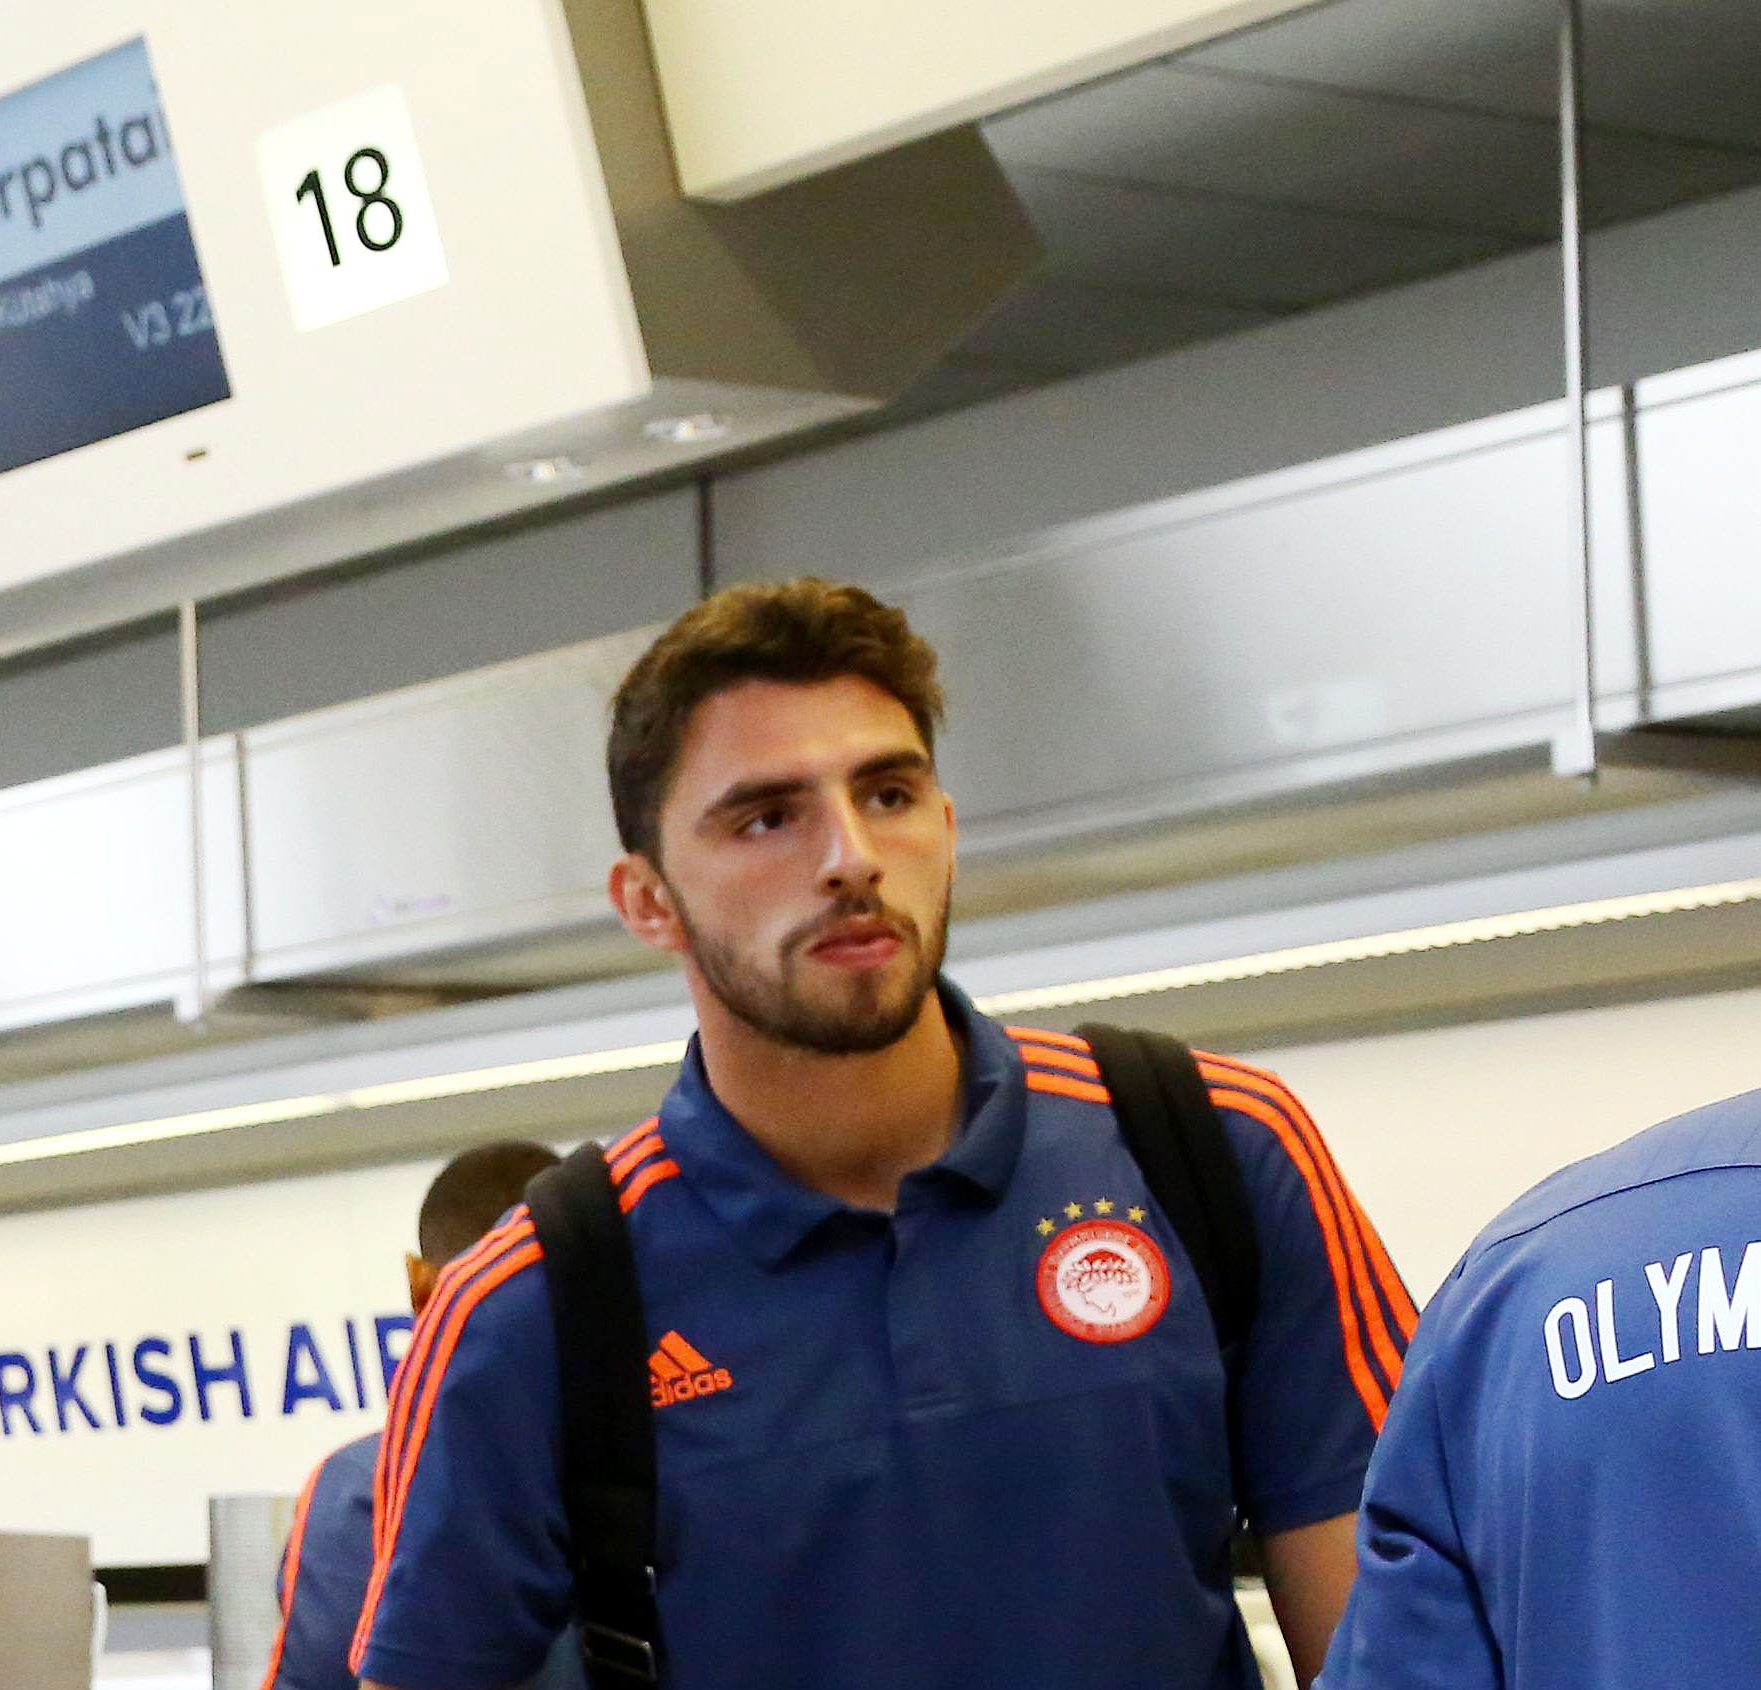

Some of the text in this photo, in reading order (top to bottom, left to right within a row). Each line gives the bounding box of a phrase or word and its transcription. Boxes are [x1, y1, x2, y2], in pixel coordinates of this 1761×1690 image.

[295, 147, 403, 267] 18
[1543, 1240, 1761, 1400] OLYM
[650, 1366, 734, 1408] didas
